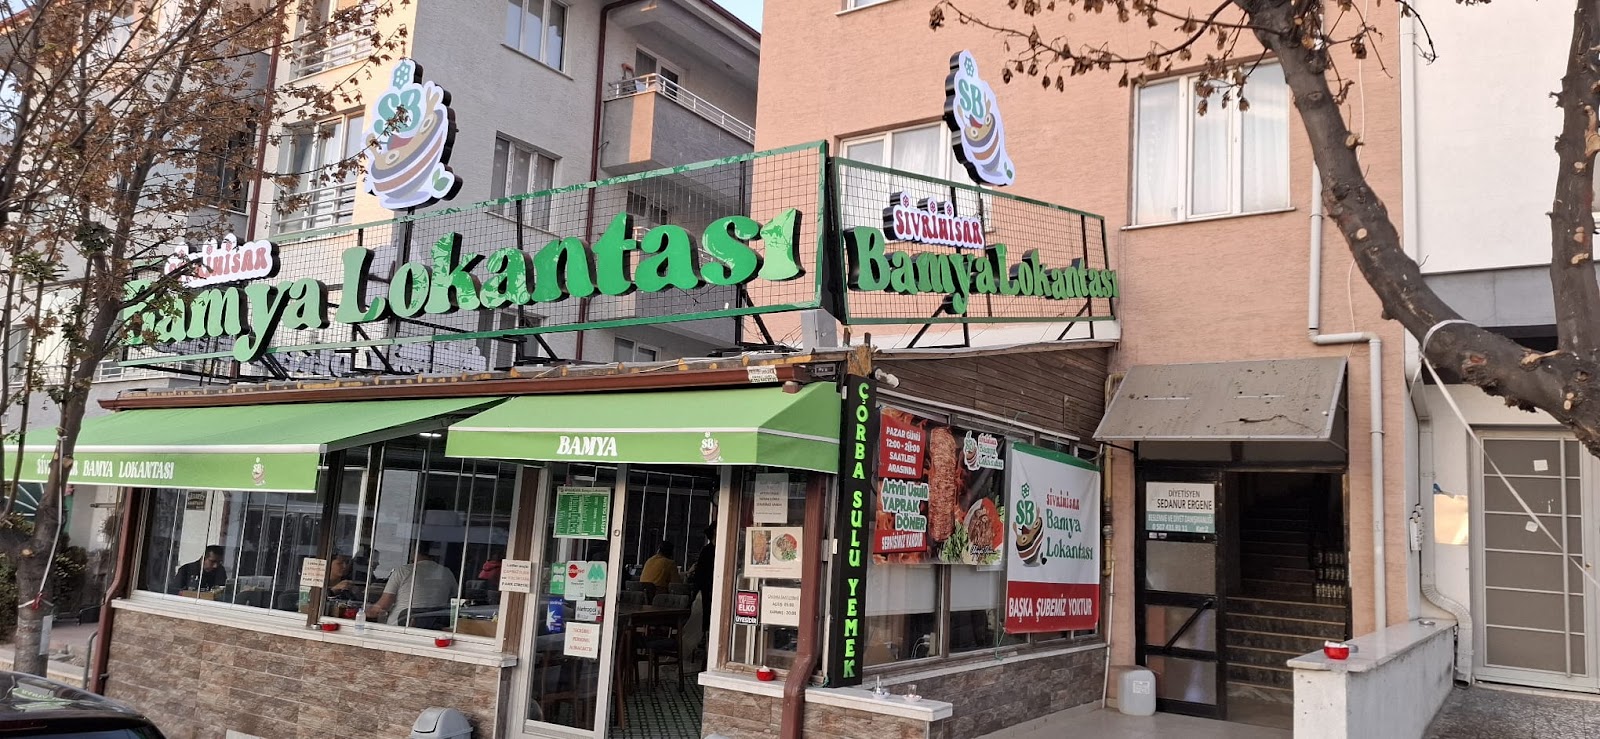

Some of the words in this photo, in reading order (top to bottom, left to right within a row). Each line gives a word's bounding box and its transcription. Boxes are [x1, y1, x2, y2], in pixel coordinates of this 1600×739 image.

[958, 78, 984, 119] SB
[374, 88, 421, 135] SB
[336, 207, 803, 325] Lokantası
[850, 225, 997, 314] Bamya
[993, 243, 1120, 300] Lokantası
[851, 382, 870, 480] ÇORBA
[886, 426, 906, 439] PAZAR
[905, 430, 921, 442] GÜNÜ
[556, 435, 618, 457] BAMYA
[701, 438, 714, 449] SB
[886, 438, 901, 450] 12:00
[889, 452, 917, 465] SAATLERİ
[83, 460, 113, 478] BAMYA
[118, 460, 175, 480] LOKANTASI
[888, 463, 917, 476] ARASINDA
[882, 479, 907, 496] Artvin
[907, 482, 929, 499] Usulü
[1168, 487, 1201, 498] DİYETİSYEN
[882, 496, 920, 513] YAPRAK
[1015, 499, 1035, 526] SB
[1156, 498, 1187, 509] SEDANUR
[1187, 499, 1213, 511] ERGENE
[848, 490, 863, 568] SULU
[896, 513, 927, 531] DÖNER
[1046, 508, 1082, 539] Bamya
[1046, 536, 1094, 560] Lokantası
[738, 603, 756, 613] ELKO
[1008, 597, 1033, 623] BAŞKA
[1036, 593, 1067, 623] ŞUBEMİZ
[1068, 597, 1093, 616] YOKTUR
[843, 578, 860, 679] YEMEK
